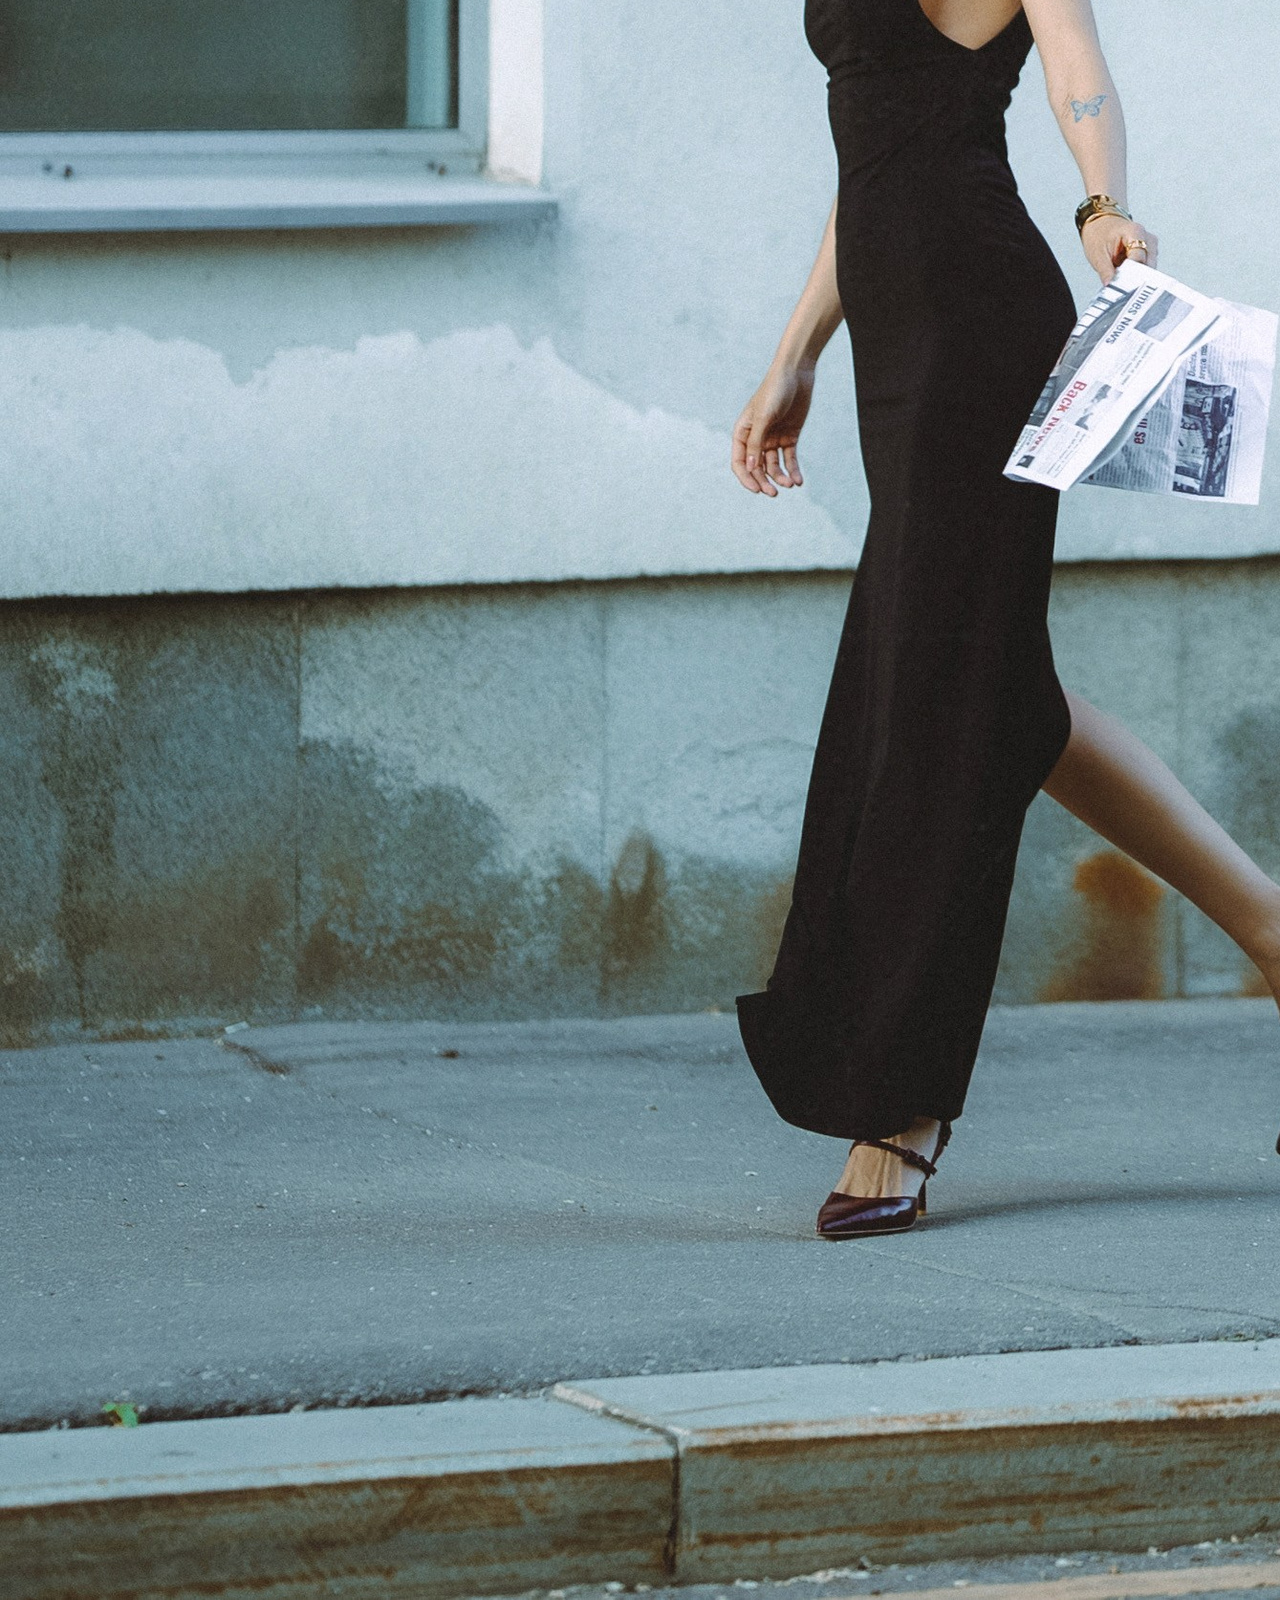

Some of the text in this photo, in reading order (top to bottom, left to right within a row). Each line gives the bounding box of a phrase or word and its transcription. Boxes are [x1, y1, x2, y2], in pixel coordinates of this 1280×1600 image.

[1128, 284, 1157, 316] Times
[1105, 317, 1133, 345] News
[1056, 380, 1088, 413] Back
